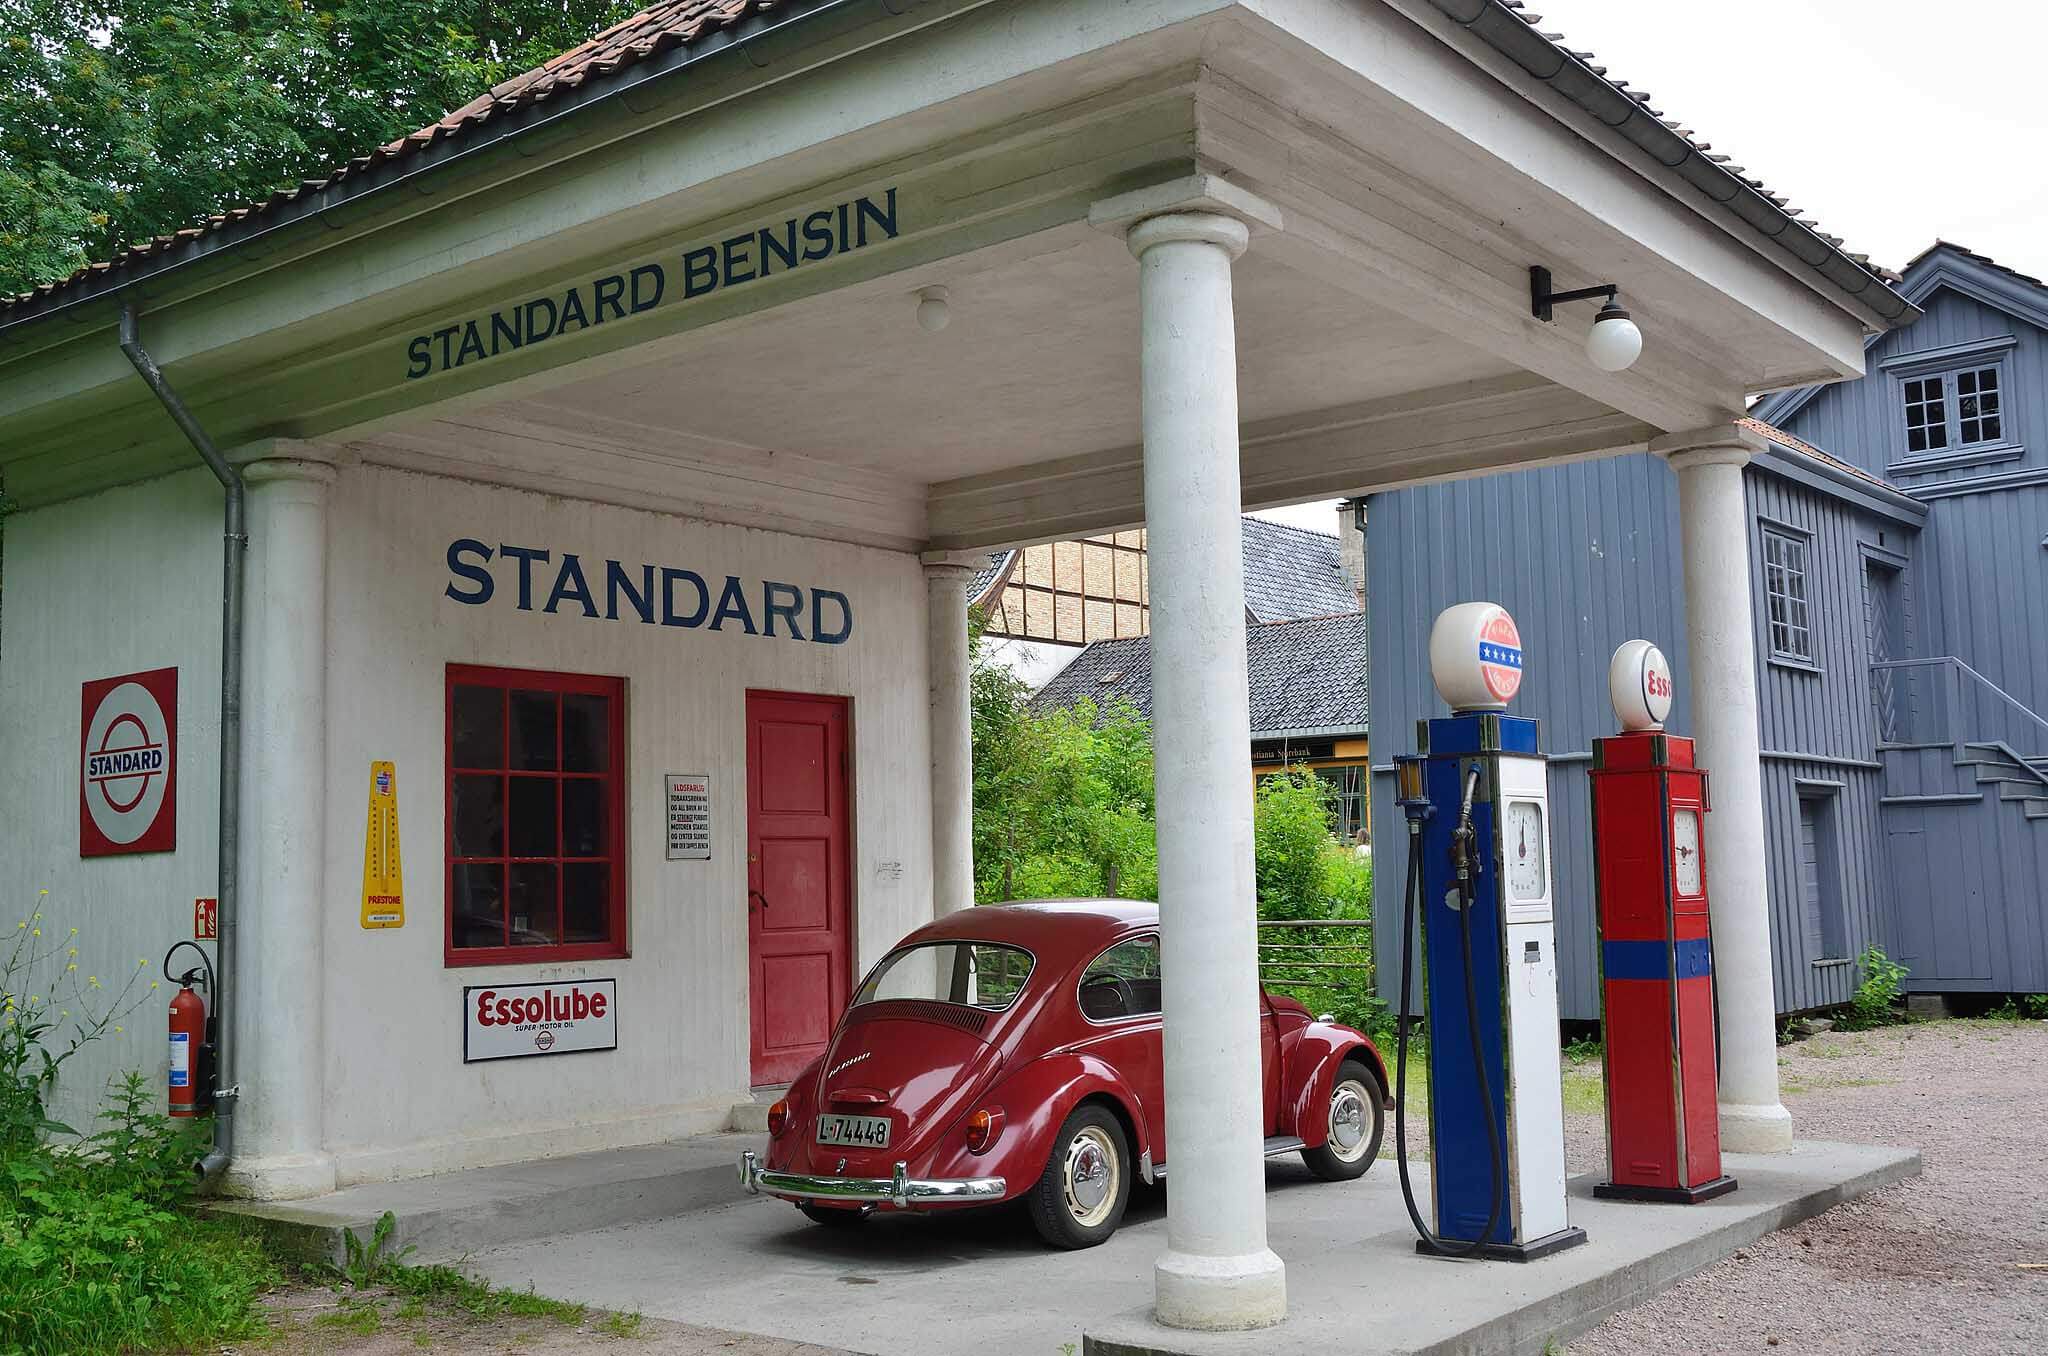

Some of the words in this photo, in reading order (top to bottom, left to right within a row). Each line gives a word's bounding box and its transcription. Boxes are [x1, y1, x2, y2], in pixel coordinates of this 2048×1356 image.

[406, 263, 665, 379] STANDARD
[682, 187, 899, 299] BENSIN
[444, 538, 853, 645] STANDARD
[89, 750, 162, 776] STANDARD
[367, 895, 401, 905] PRESTONE
[477, 987, 608, 1027] Essolube
